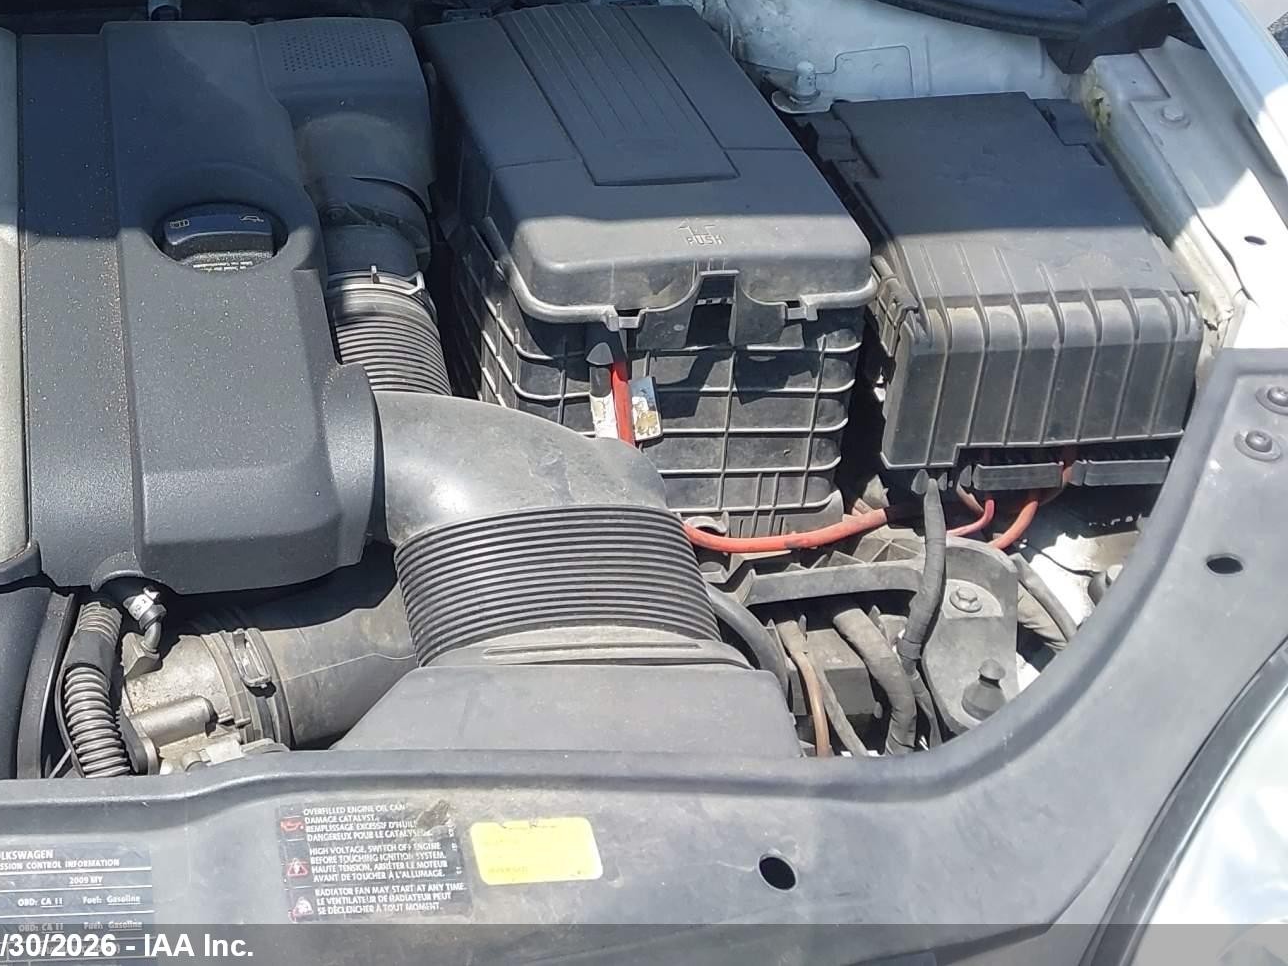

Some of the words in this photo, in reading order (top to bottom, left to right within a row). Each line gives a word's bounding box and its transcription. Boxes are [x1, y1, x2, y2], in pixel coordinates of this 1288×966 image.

[686, 234, 723, 246] PUSH
[303, 806, 345, 816] OVERFILLED
[347, 805, 374, 814] ENGINE
[376, 804, 389, 812] OIL
[305, 815, 337, 824] DAMAGE
[306, 823, 353, 833] REMPLISSAGE
[356, 822, 386, 831] EXCESSIF
[307, 832, 352, 842] DANGEREUX
[353, 831, 374, 840] POUR
[375, 830, 384, 838] LE
[310, 847, 329, 856] HIGH
[368, 844, 397, 853] SWITCH
[413, 842, 441, 851] ENGINE
[26, 860, 62, 870] CONTROL
[65, 858, 120, 868] INFORMATION
[311, 855, 337, 865] BEFORE
[338, 853, 378, 863] TOUCHING
[379, 852, 412, 862] IGNITION
[312, 864, 337, 874] HAUTE
[406, 861, 415, 870] LE
[416, 860, 448, 869] MOTEUR
[69, 876, 89, 885] 2009
[313, 873, 338, 883] AVANT
[342, 873, 352, 882] DE
[353, 871, 387, 881] TOUCHER
[314, 887, 353, 897] RADIATOR
[355, 886, 371, 895] FAN
[372, 885, 389, 894] MAY
[392, 884, 414, 893] START
[416, 883, 426, 892] AT
[428, 883, 444, 892] ANY
[41, 897, 52, 906] CA
[83, 895, 103, 904] Fuel:
[106, 893, 141, 904] Gasoline
[317, 897, 325, 906] LE
[326, 895, 376, 905] VENTILATEUR
[377, 894, 388, 903] DE
[389, 893, 432, 903] RADIATEUR
[432, 892, 452, 901] PEUT
[317, 906, 327, 915] SE
[382, 903, 402, 913] TOUT
[108, 920, 142, 929] Gasoline
